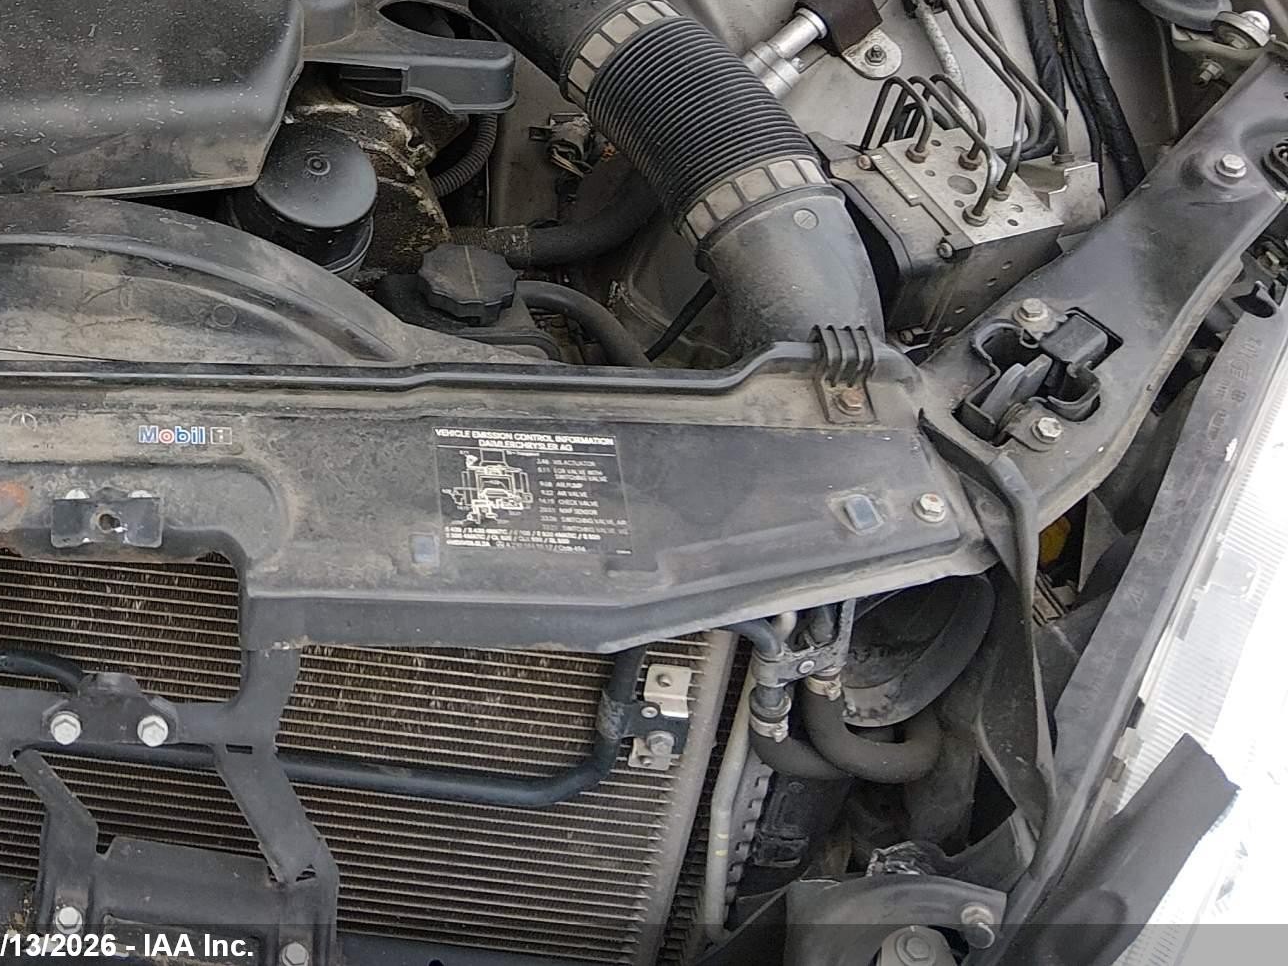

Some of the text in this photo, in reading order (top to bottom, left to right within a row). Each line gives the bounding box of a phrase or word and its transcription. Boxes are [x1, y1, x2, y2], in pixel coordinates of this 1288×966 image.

[138, 425, 205, 445] Mobil
[435, 429, 614, 446] VEHICLE EMISSION CONTROL INFORMATION
[478, 439, 573, 452] DAIMLERCHRYSLER AG
